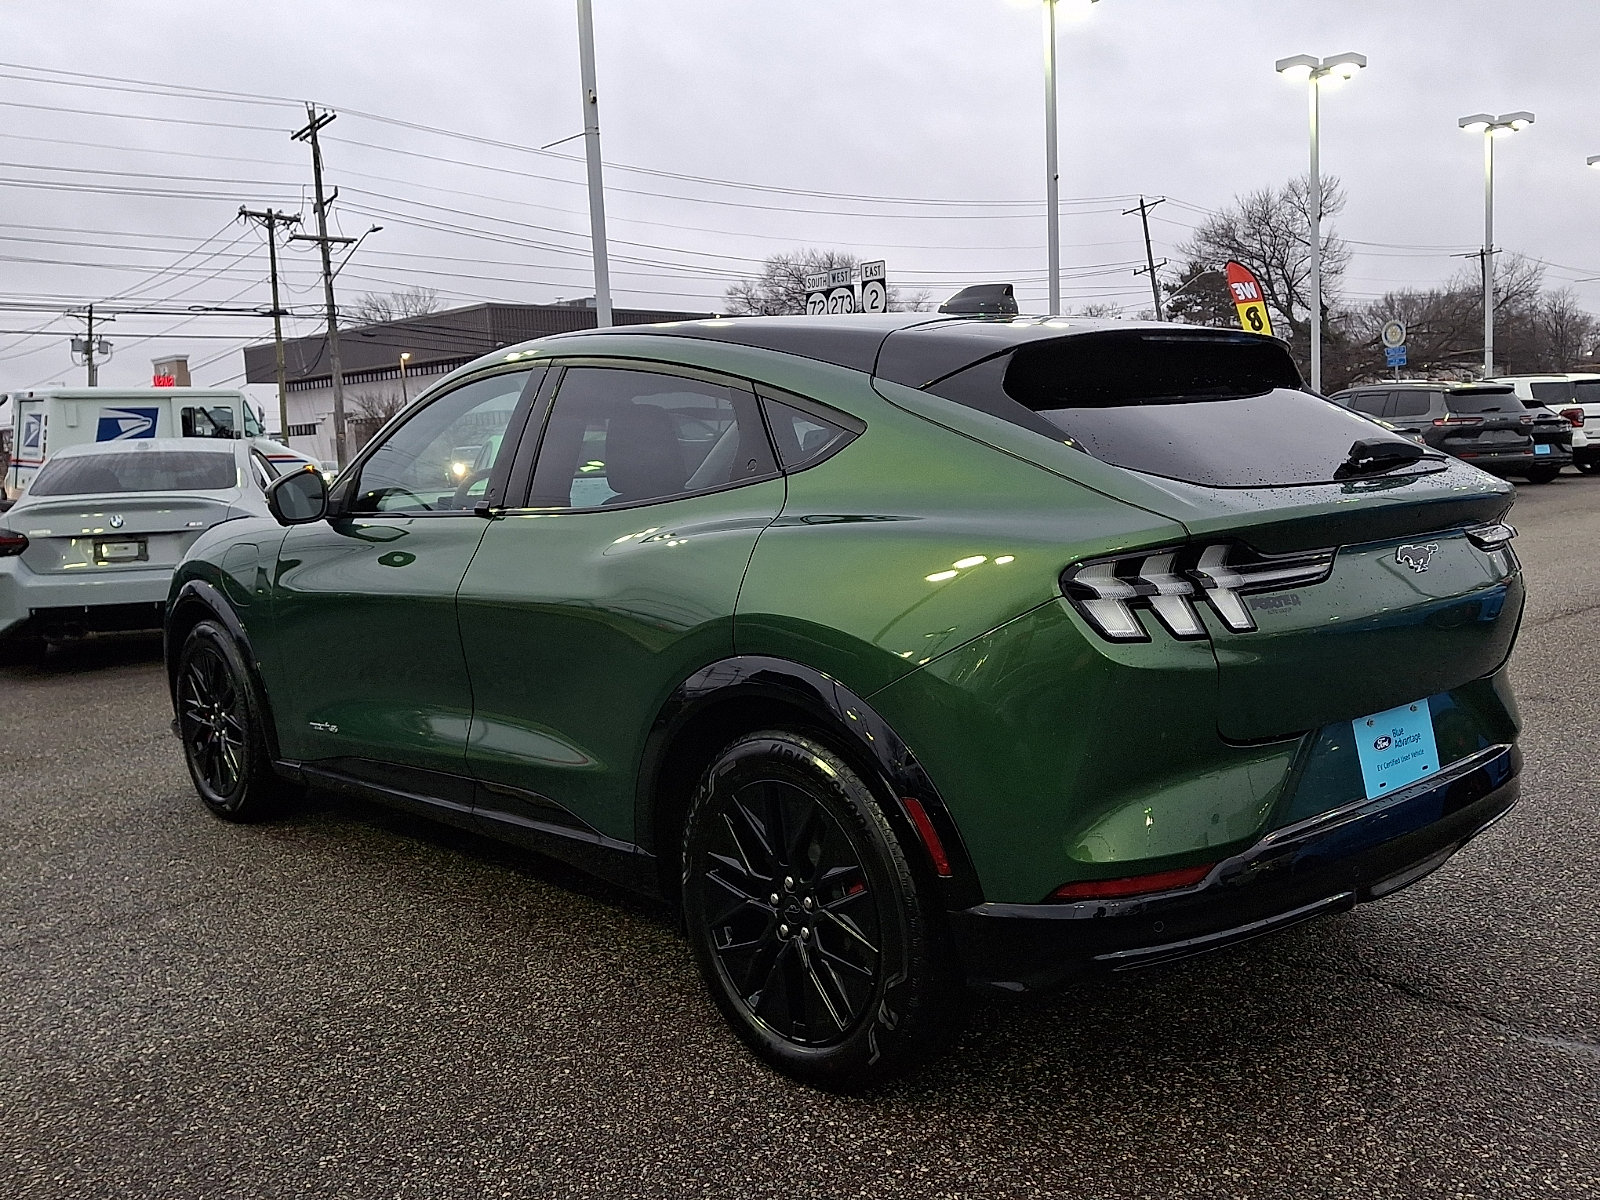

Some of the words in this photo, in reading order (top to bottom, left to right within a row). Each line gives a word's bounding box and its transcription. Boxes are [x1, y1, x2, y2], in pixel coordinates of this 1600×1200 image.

[831, 271, 848, 283] WEST
[865, 265, 881, 277] EAST
[807, 276, 826, 288] SOUTH
[831, 294, 852, 314] 273
[870, 289, 880, 309] 2
[809, 300, 825, 315] 72
[1392, 728, 1404, 738] Blue
[1375, 737, 1391, 750] Ford
[1394, 733, 1421, 748] Advantage
[1383, 756, 1400, 770] Certified
[1400, 753, 1411, 764] Used
